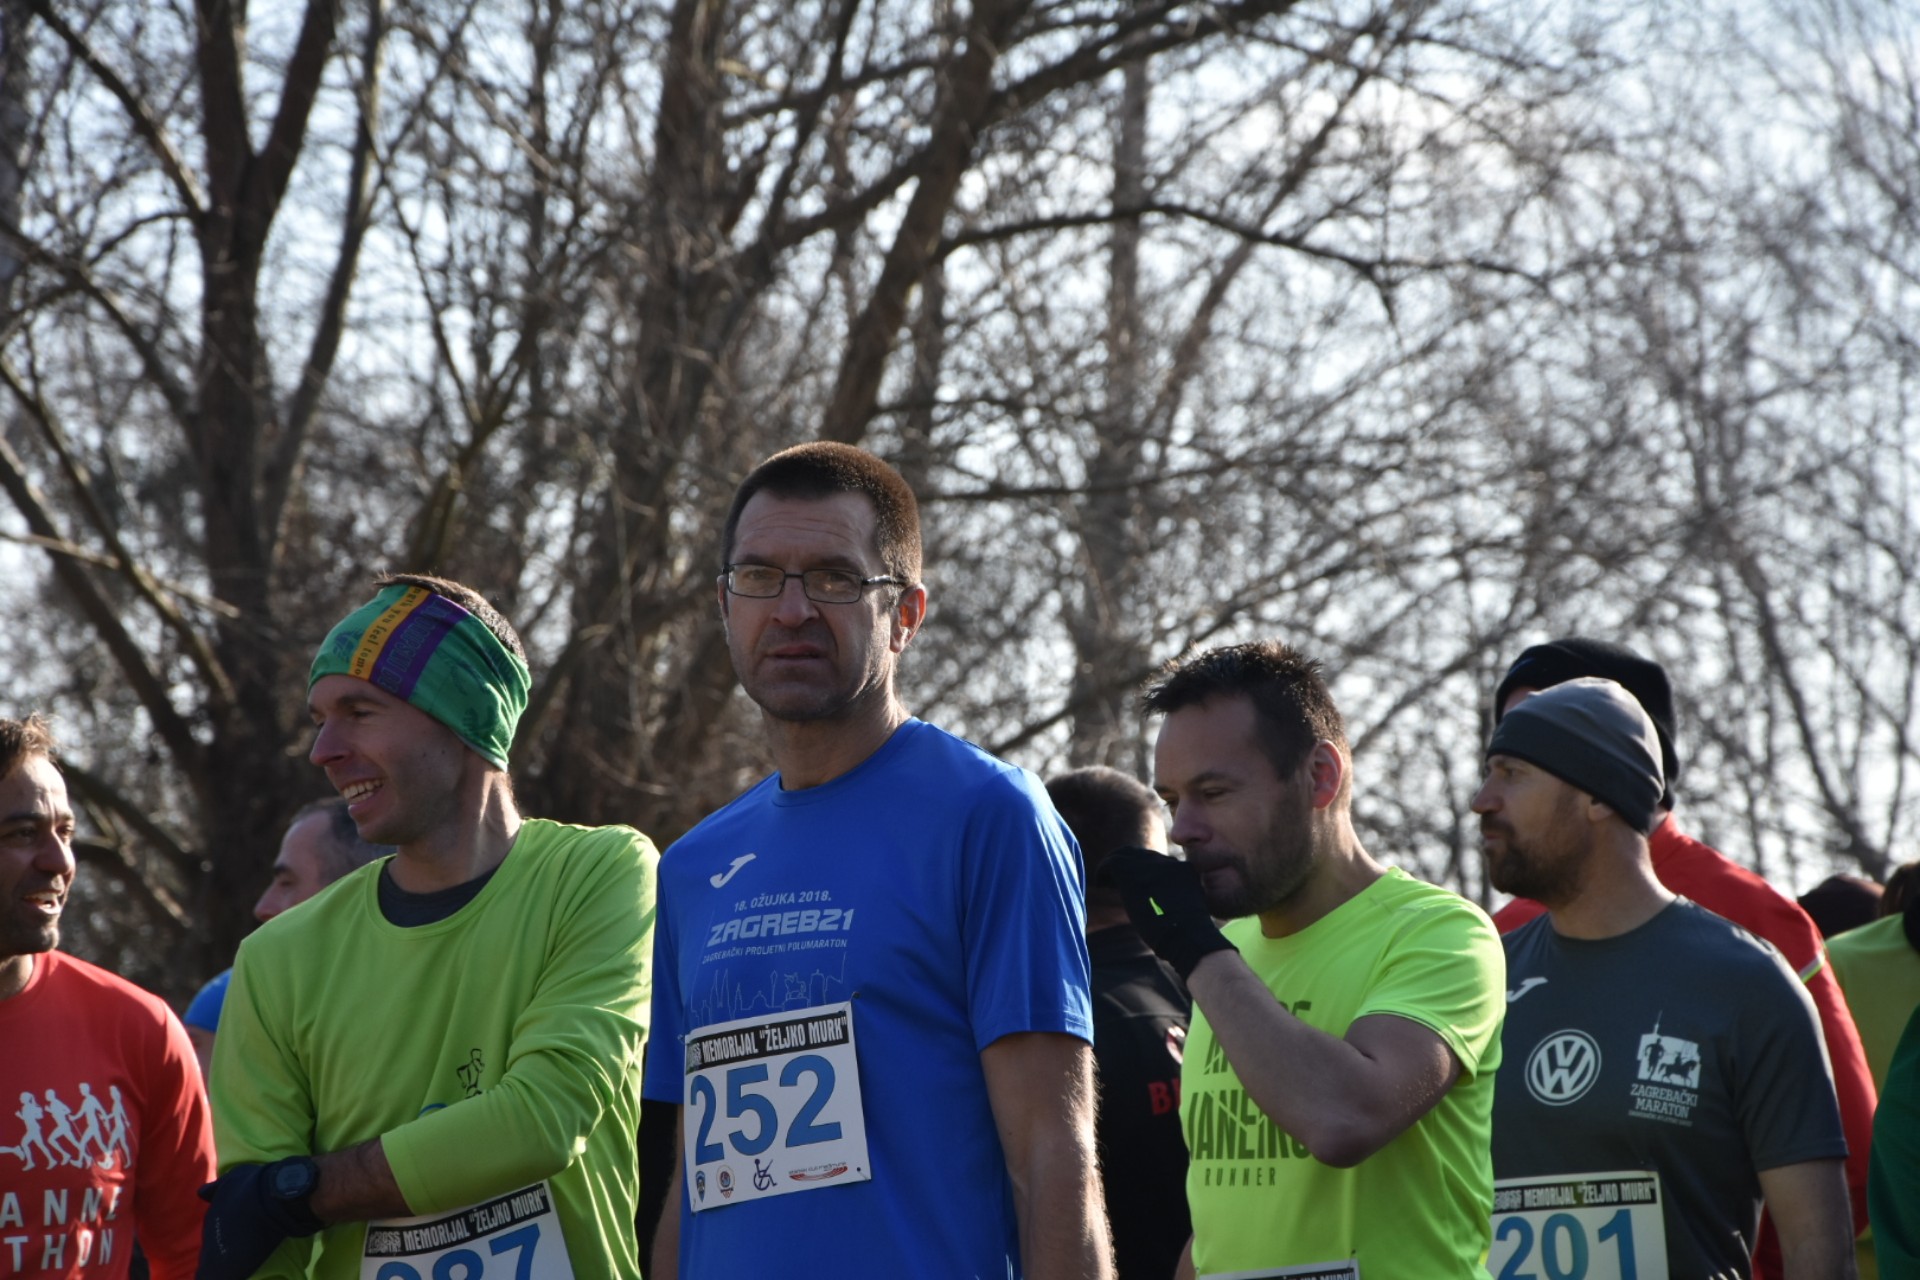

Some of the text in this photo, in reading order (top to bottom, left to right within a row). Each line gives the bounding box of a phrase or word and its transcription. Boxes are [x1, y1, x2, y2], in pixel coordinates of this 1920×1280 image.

[367, 625, 387, 645] feel
[734, 890, 832, 913] 18. OŽUJKA 2018.
[706, 908, 855, 947] ZAGREB21
[745, 943, 786, 955] PROLJETNI
[787, 939, 848, 951] POLUMARATON
[702, 1030, 759, 1063] MEMORIJAL
[760, 1021, 805, 1052] "ŽELJKO
[808, 1016, 848, 1045] MURK"
[1630, 1083, 1698, 1108] ZAGREBAČKI
[1635, 1097, 1691, 1119] MARATON
[690, 1054, 842, 1166] 252
[1205, 1167, 1276, 1186] RUNNER
[1523, 1186, 1576, 1208] MEMORIJAL
[403, 1217, 470, 1252] MEMORIJAL
[469, 1204, 512, 1234] "ŽELJKO
[511, 1187, 546, 1219] MURK"
[4, 1228, 113, 1273] THON
[1495, 1208, 1638, 1280] 201
